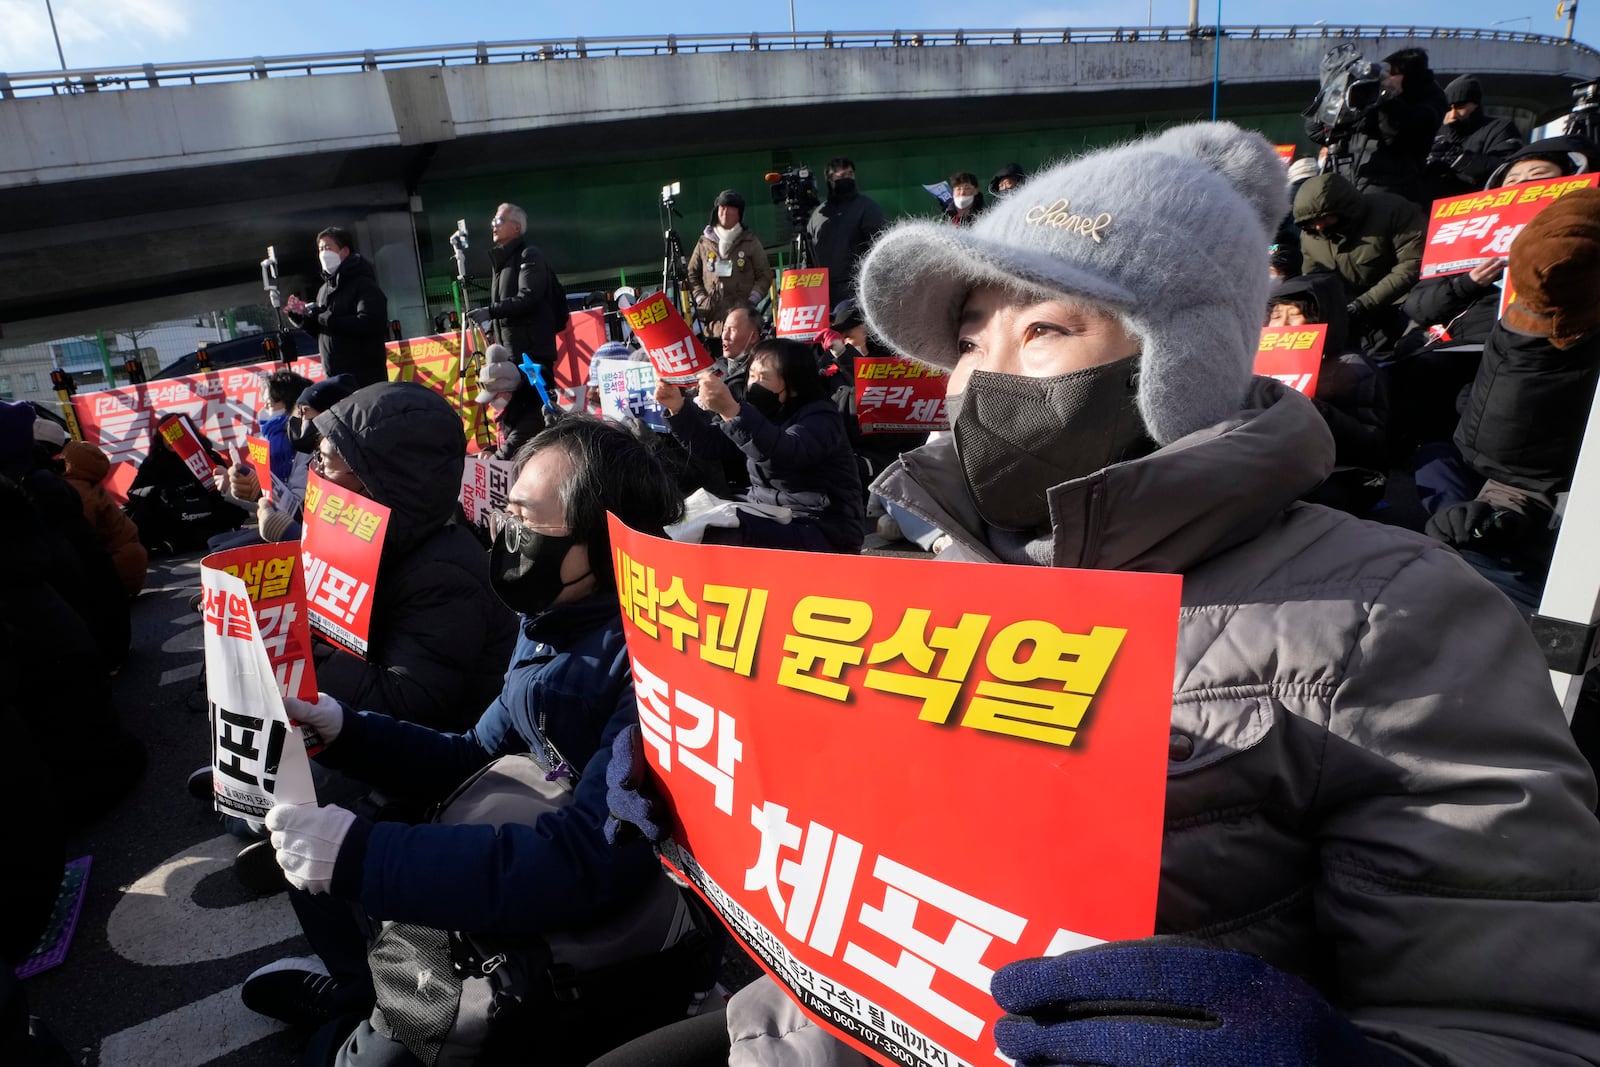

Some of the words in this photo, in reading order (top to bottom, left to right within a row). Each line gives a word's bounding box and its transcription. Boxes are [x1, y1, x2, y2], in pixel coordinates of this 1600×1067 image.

[1434, 188, 1518, 219] 내란수괴
[1430, 213, 1500, 245] 즉각
[785, 273, 824, 290] 윤석열
[630, 298, 669, 330] 윤석열
[650, 335, 698, 373] 체포!
[1258, 331, 1319, 351] 윤석열
[860, 386, 914, 409] 즉각
[319, 493, 383, 543] 윤석열
[202, 583, 254, 642] 석열
[253, 602, 298, 658] 각
[616, 546, 769, 678] 내란수괴
[777, 595, 1128, 747] 윤석열
[210, 700, 287, 795] 포!
[632, 655, 743, 818] 즉각
[788, 955, 815, 990] 즉각
[820, 977, 862, 1016] 구속!
[891, 1019, 950, 1067] 때까지
[809, 995, 832, 1017] ARS
[833, 1011, 914, 1067] 060-707-3300
